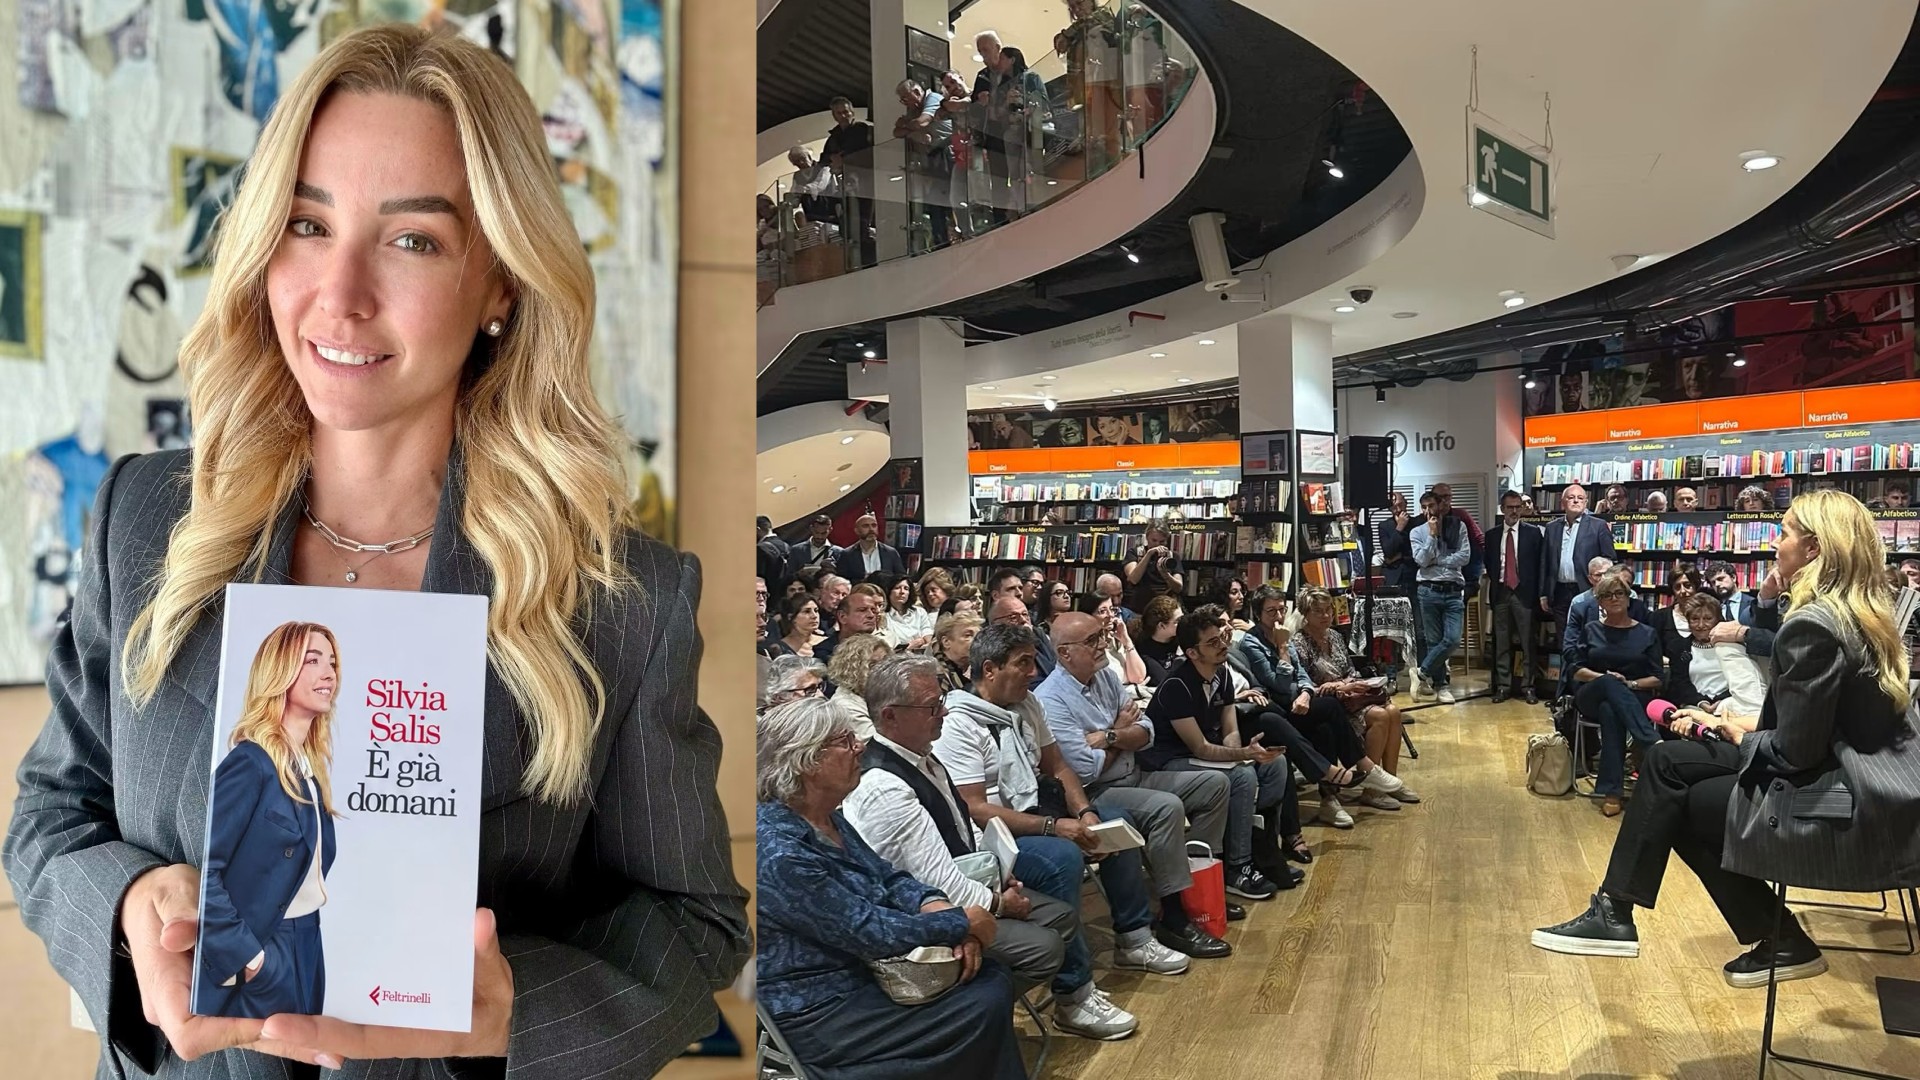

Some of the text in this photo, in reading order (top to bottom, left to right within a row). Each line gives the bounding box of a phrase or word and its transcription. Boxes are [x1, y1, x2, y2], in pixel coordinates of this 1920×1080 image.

[1808, 412, 1848, 423] Narrativa
[1703, 420, 1739, 431] Narrativa
[1610, 428, 1642, 438] Narrativa
[1824, 431, 1843, 439] Ordine
[1415, 430, 1455, 452] Info
[1528, 436, 1557, 444] Narrativa
[1760, 512, 1785, 520] Rosa/Co
[1882, 510, 1918, 518] Alfabetico
[366, 679, 448, 711] Silvia
[370, 712, 441, 745] Salis
[365, 741, 443, 788] È già
[347, 782, 458, 817] domani
[382, 990, 431, 1004] Feltrinelli
